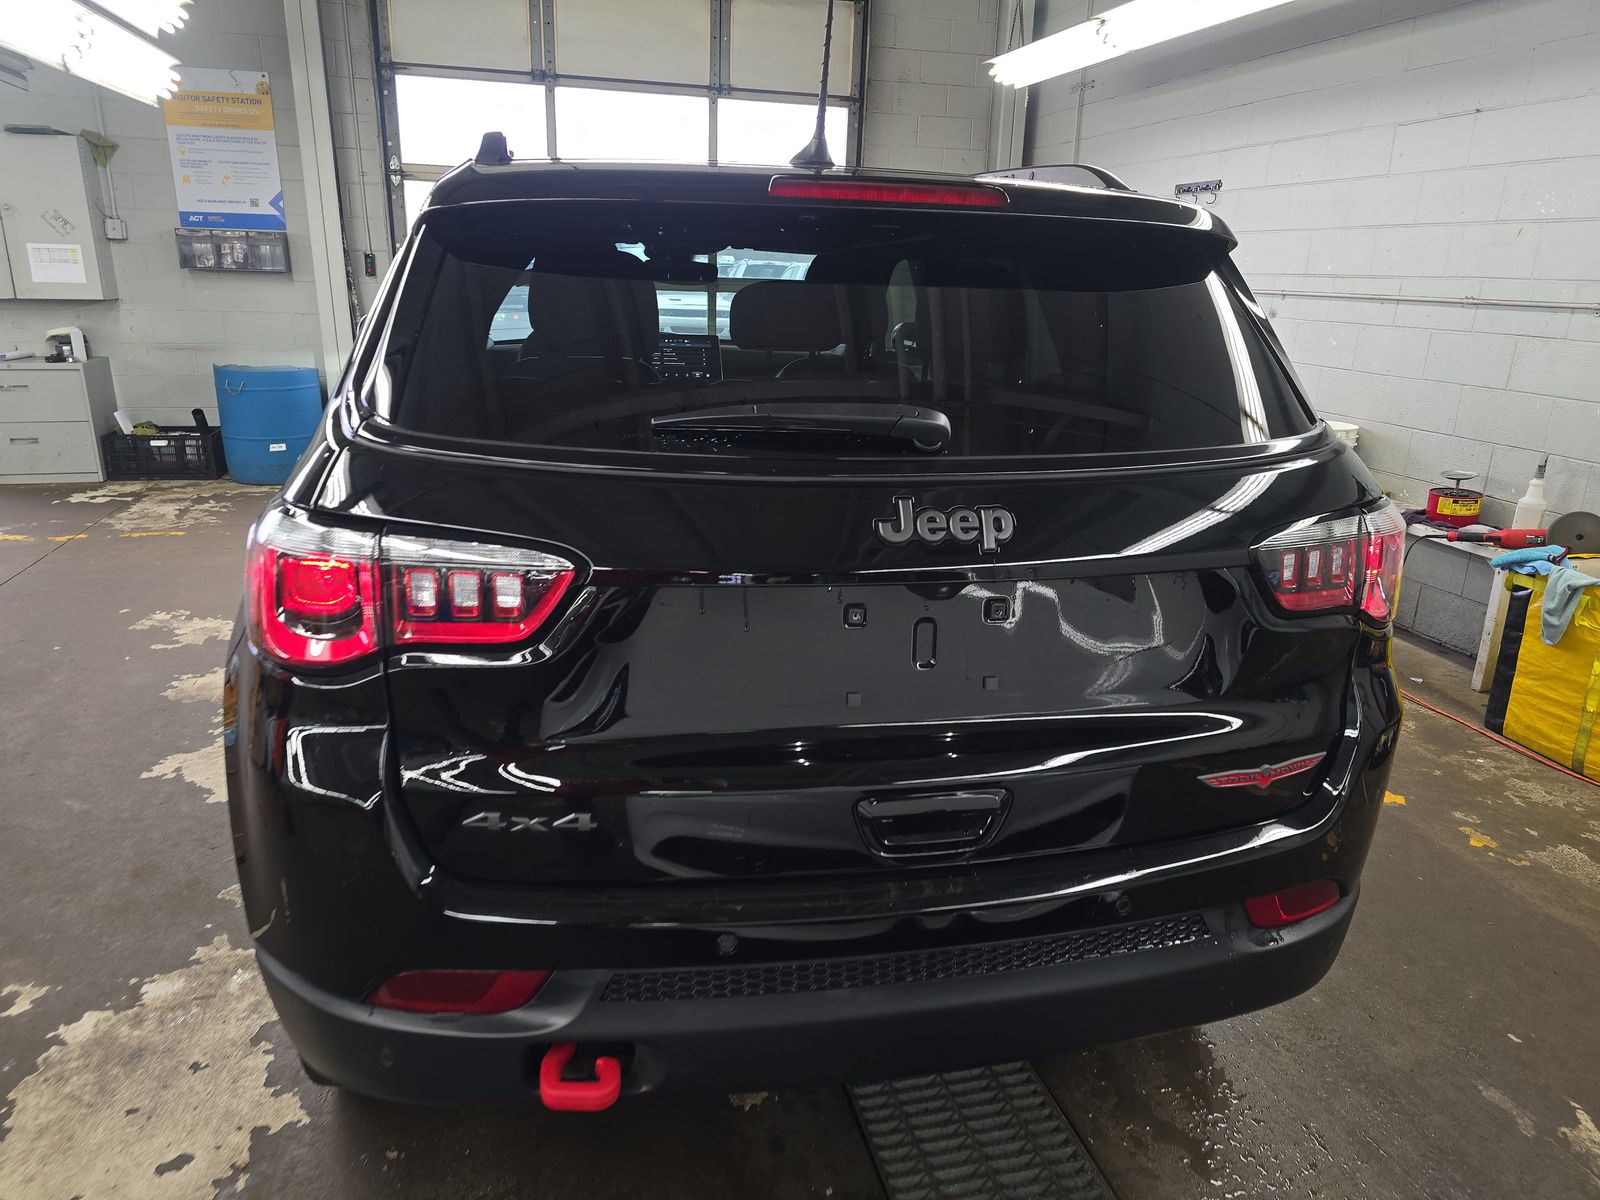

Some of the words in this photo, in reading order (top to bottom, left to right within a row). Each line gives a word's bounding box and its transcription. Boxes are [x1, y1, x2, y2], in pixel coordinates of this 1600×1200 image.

[172, 94, 201, 102] VISITOR
[202, 95, 230, 104] SAFETY
[231, 97, 263, 105] STATION
[876, 498, 1015, 552] Jeep
[462, 812, 598, 831] 4x4
